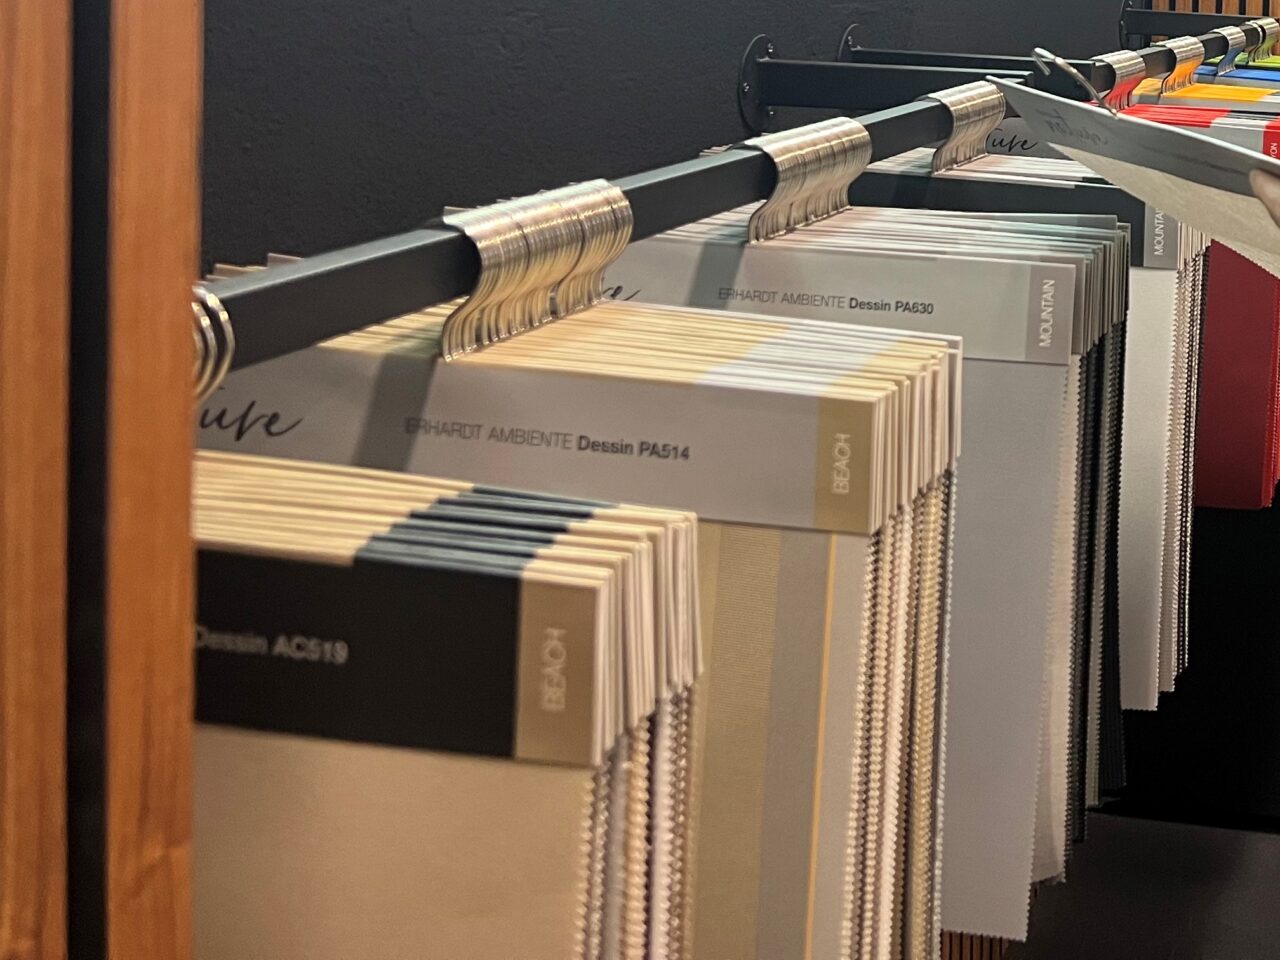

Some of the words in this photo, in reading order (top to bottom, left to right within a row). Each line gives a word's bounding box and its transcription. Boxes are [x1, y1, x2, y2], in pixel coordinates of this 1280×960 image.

[1154, 207, 1165, 256] MOUNTAI
[717, 287, 777, 304] ERHARDT
[780, 291, 845, 309] AMBIENTE
[849, 297, 891, 312] Dessin
[895, 300, 934, 315] PA630
[1039, 279, 1056, 347] MOUNTAIN
[404, 416, 483, 440] ERHARDT
[487, 425, 573, 449] AMBIENTE
[577, 435, 634, 456] Dessin
[638, 440, 690, 461] PA514
[832, 433, 851, 495] BEACH
[541, 627, 567, 712] BEACH
